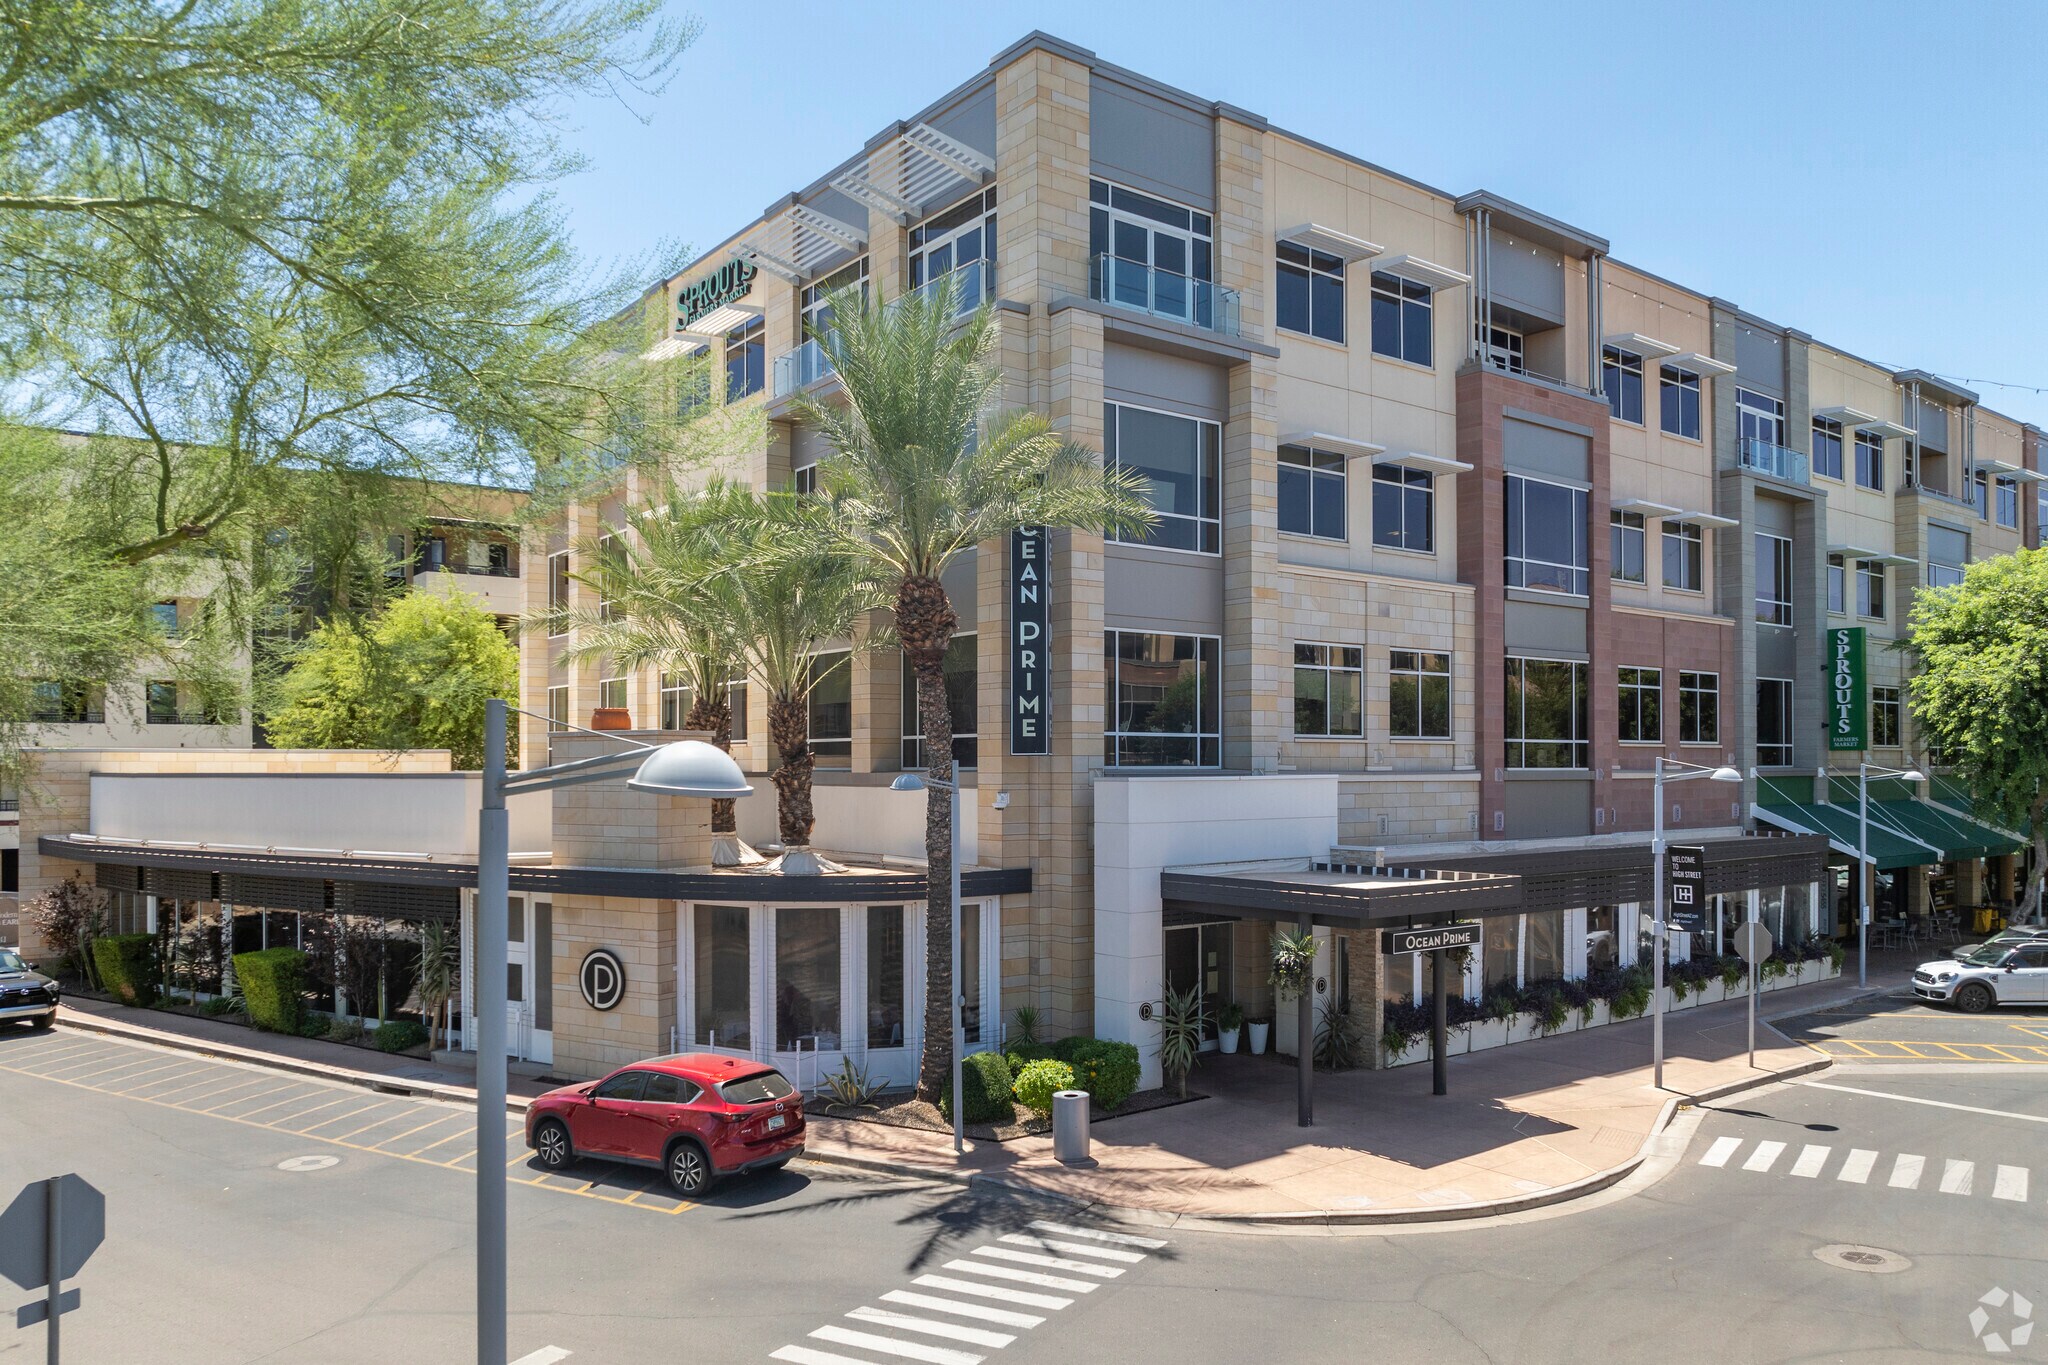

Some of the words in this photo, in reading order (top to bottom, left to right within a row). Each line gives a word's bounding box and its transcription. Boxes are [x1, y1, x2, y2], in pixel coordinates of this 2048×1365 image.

[675, 256, 756, 331] SPROUTS
[719, 282, 751, 307] MARKET
[1019, 523, 1039, 604] CEAN
[1019, 621, 1040, 737] PRIME
[1834, 629, 1853, 734] SPROUTS
[1671, 855, 1696, 864] WELCOME
[1684, 871, 1702, 879] STREET
[1405, 935, 1441, 949] OCEAN
[1443, 932, 1471, 945] PRIME
